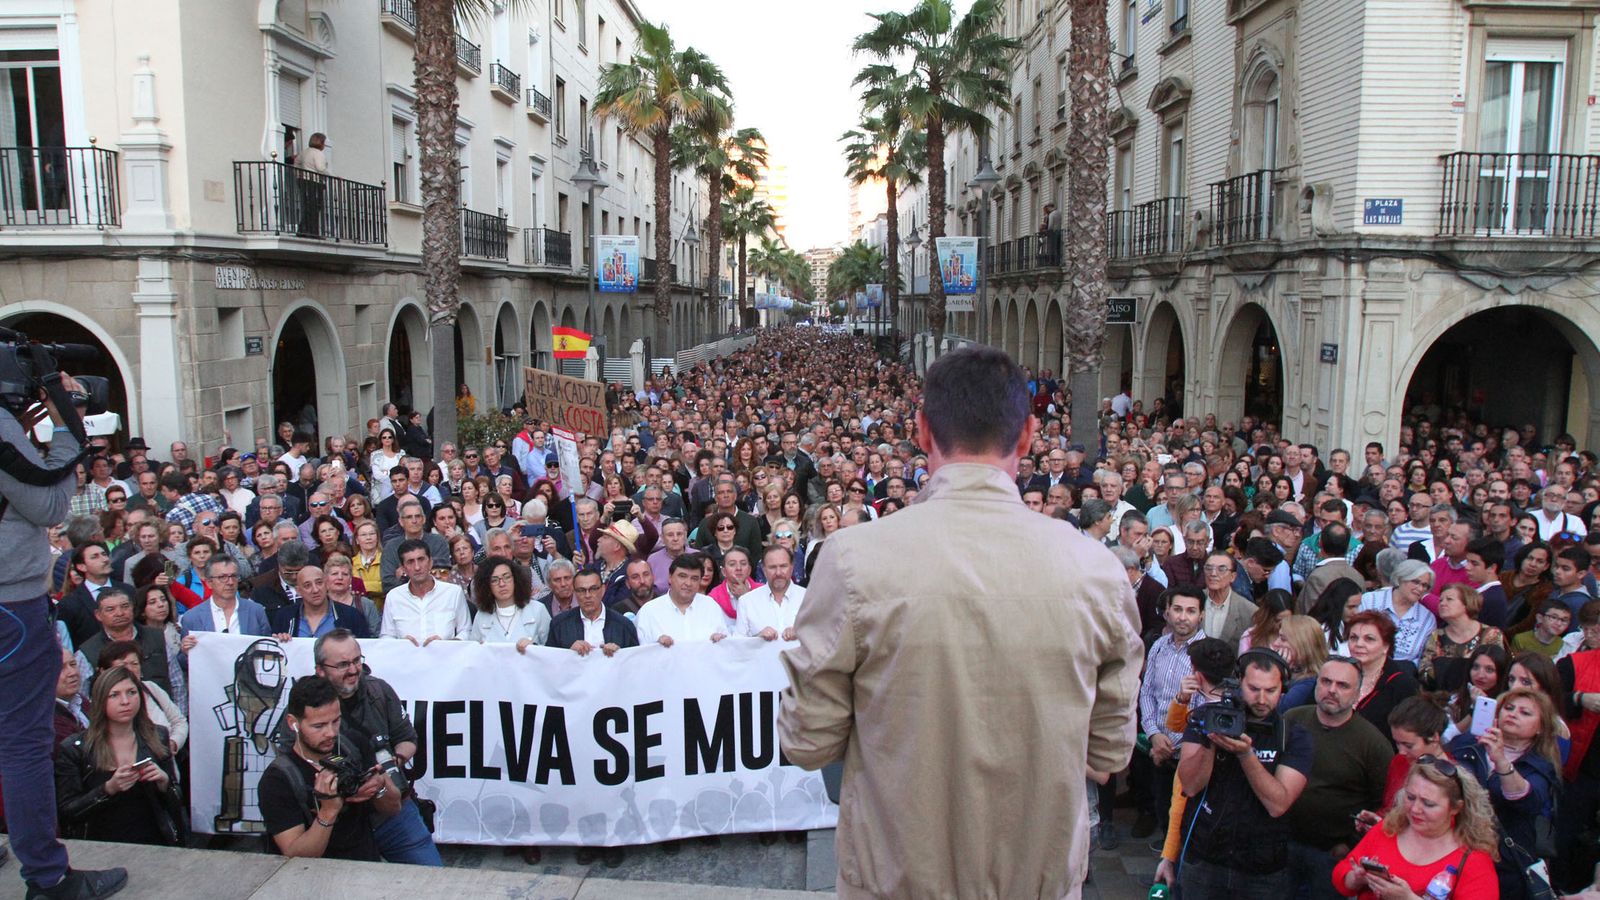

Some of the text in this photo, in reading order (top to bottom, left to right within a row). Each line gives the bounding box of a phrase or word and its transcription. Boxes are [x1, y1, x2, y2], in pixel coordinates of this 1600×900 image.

[1365, 215, 1377, 224] LAS
[525, 369, 602, 408] HUELVA CADIZ
[527, 395, 549, 420] POR
[550, 400, 567, 425] LA
[566, 405, 607, 438] COSTA
[592, 700, 665, 786] SE
[683, 691, 797, 776] MU
